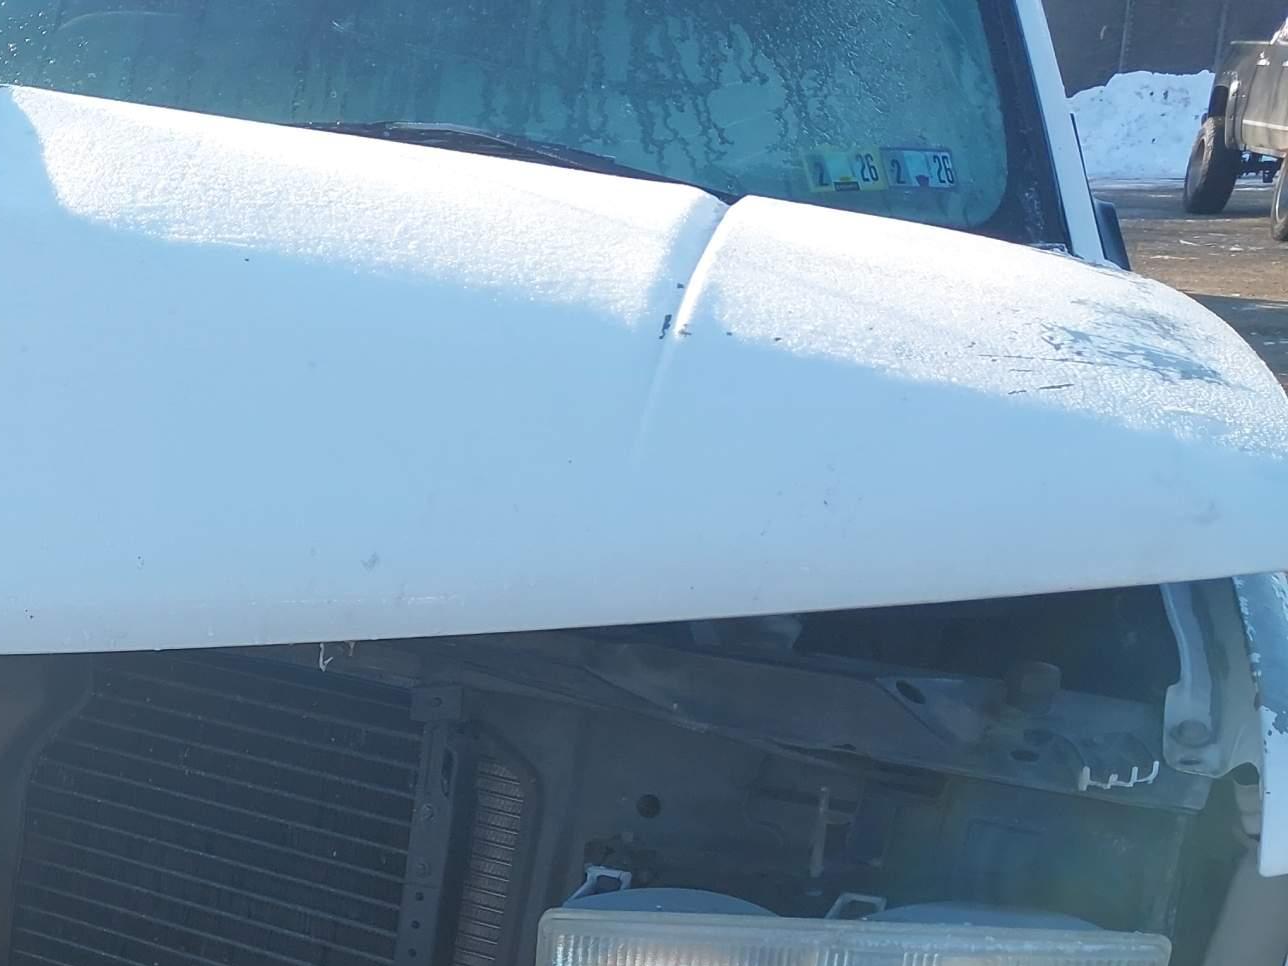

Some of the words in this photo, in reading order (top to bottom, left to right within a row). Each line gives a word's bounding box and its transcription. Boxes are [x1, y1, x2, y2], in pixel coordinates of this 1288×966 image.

[814, 162, 829, 187] 2
[856, 153, 879, 182] 26
[892, 159, 906, 184] 2
[933, 155, 955, 184] 26
